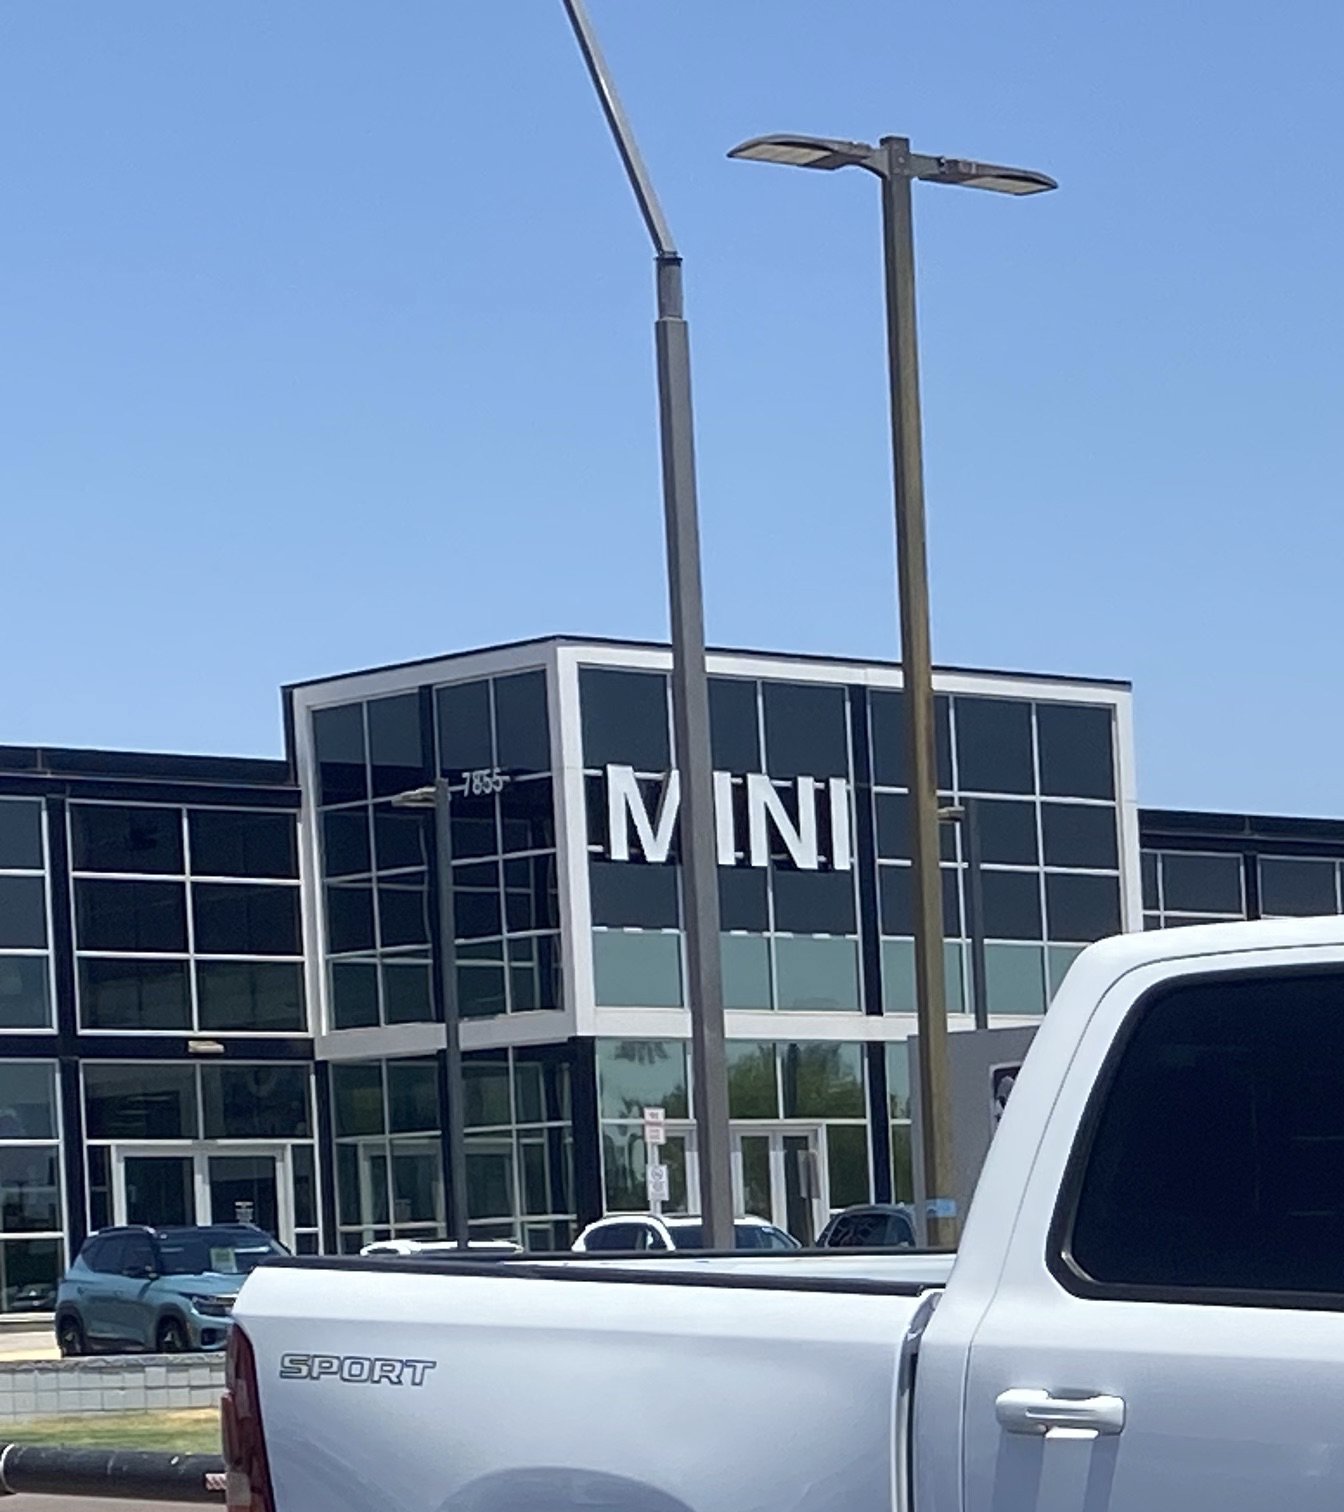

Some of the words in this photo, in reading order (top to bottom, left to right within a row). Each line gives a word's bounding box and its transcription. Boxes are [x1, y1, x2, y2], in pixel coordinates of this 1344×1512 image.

[461, 767, 504, 797] 7855
[606, 763, 850, 871] MINI
[279, 1353, 437, 1387] SPORT
